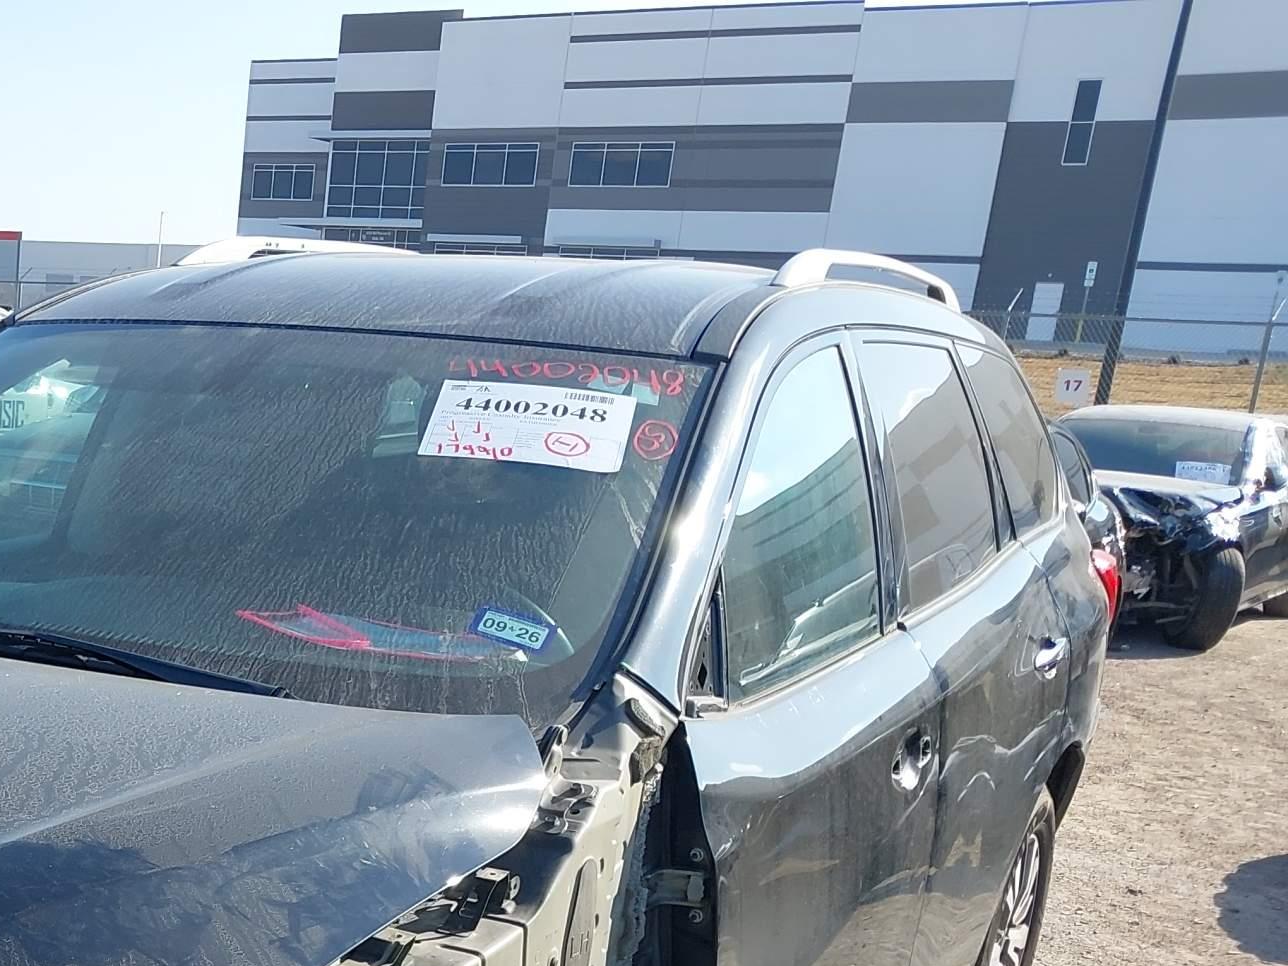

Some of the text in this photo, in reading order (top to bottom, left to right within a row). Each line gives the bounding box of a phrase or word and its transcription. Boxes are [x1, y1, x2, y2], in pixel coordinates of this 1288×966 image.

[449, 353, 686, 396] 44002048
[1064, 380, 1083, 392] 17
[455, 396, 608, 424] 44002048
